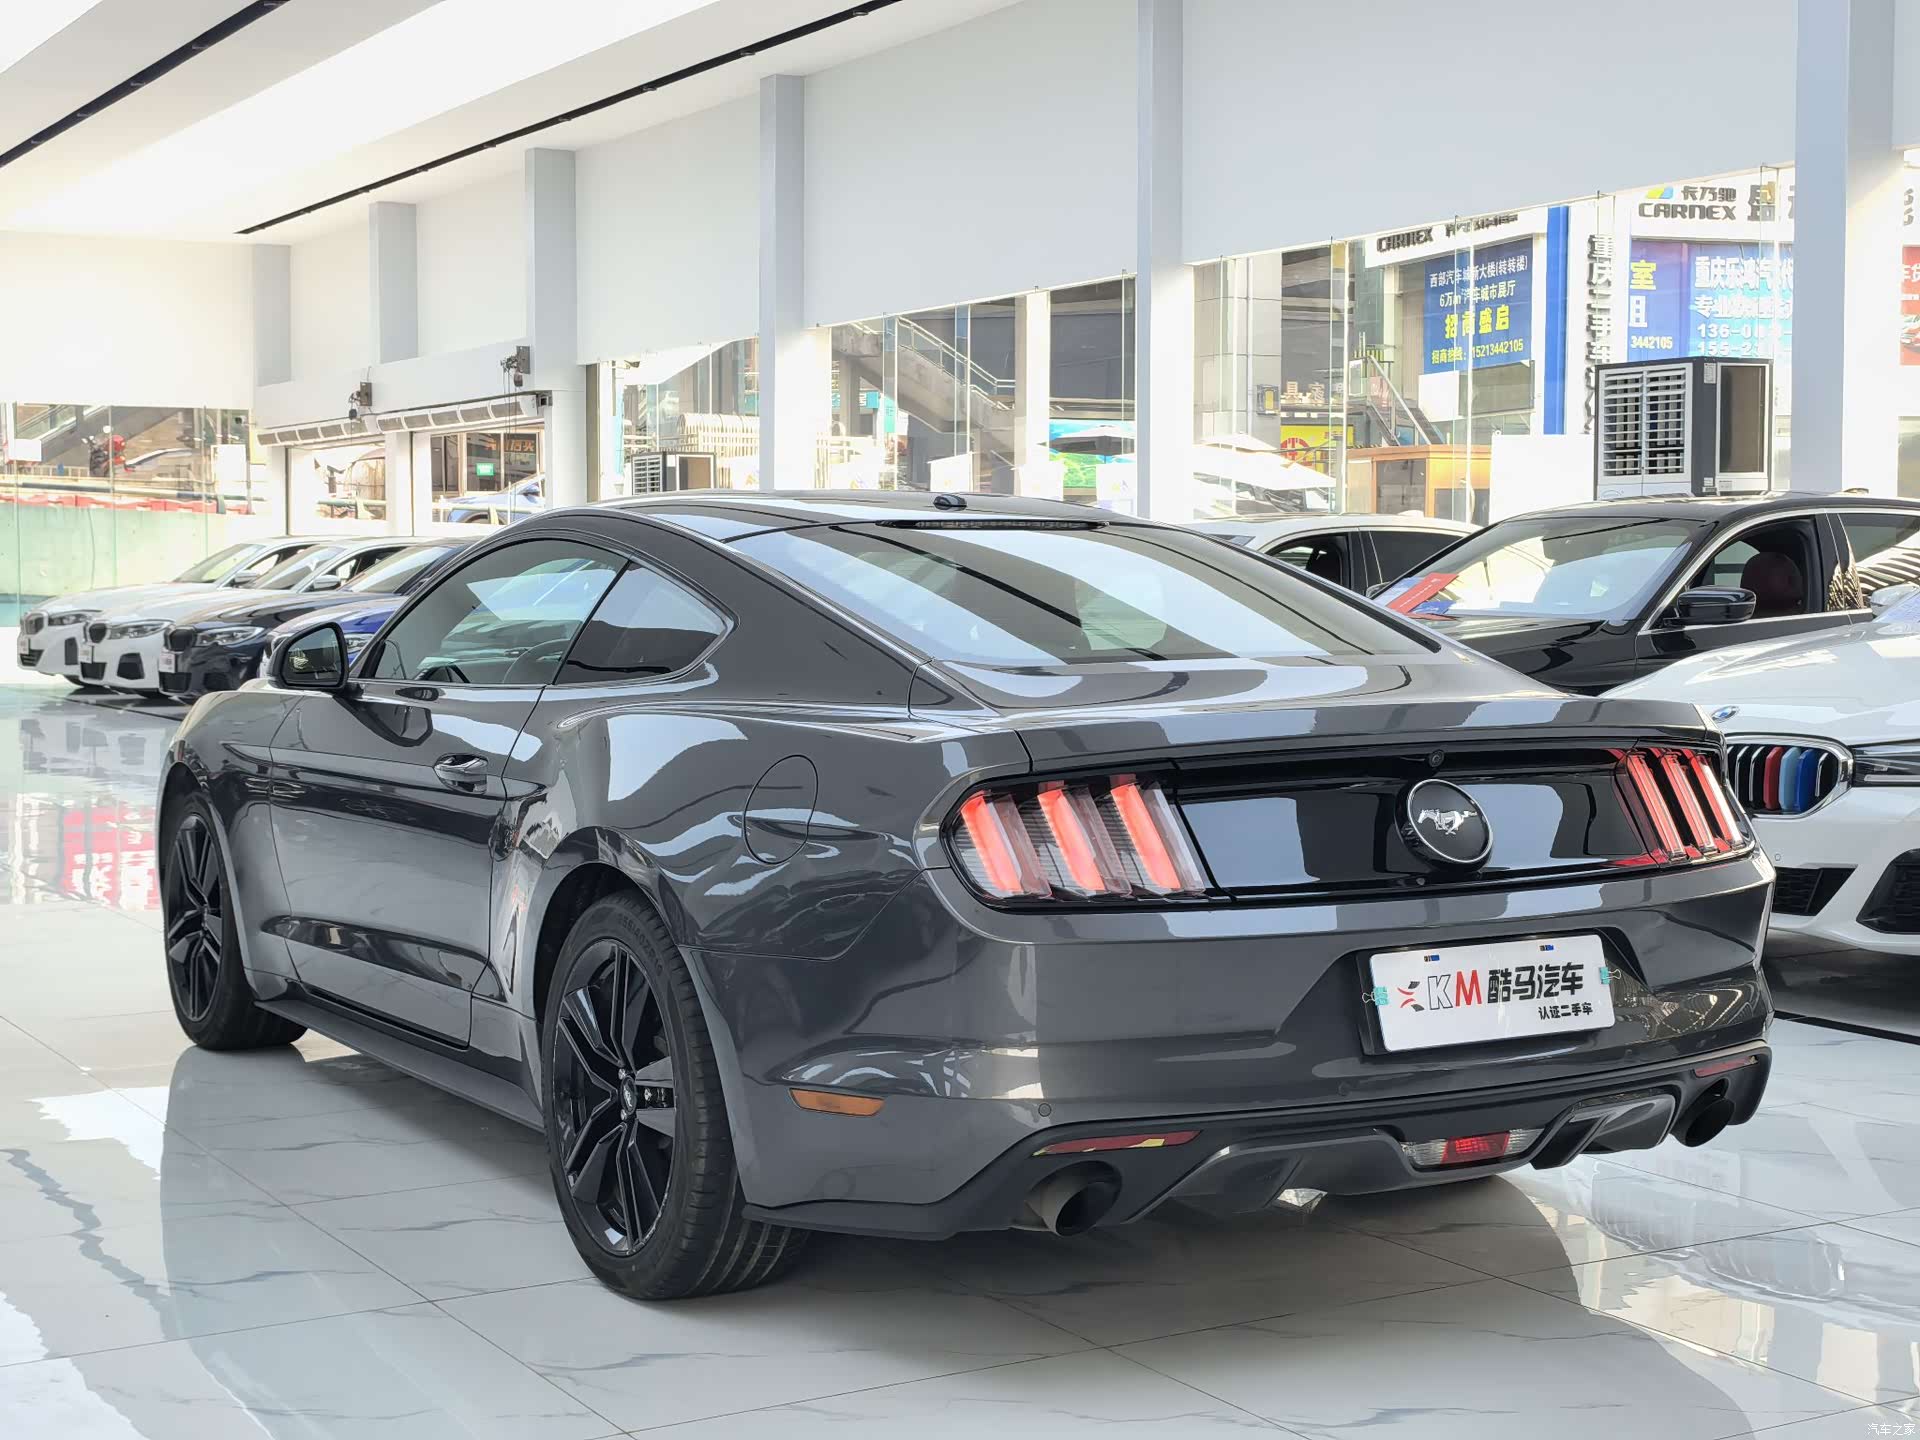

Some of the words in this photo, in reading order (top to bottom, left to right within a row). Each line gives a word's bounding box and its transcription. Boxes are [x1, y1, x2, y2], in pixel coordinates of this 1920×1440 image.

[1638, 203, 1737, 221] CARNEX
[1427, 969, 1483, 1011] KM
[1487, 962, 1584, 1004] 酷马汽车
[1538, 1002, 1594, 1020] 认证二手车
